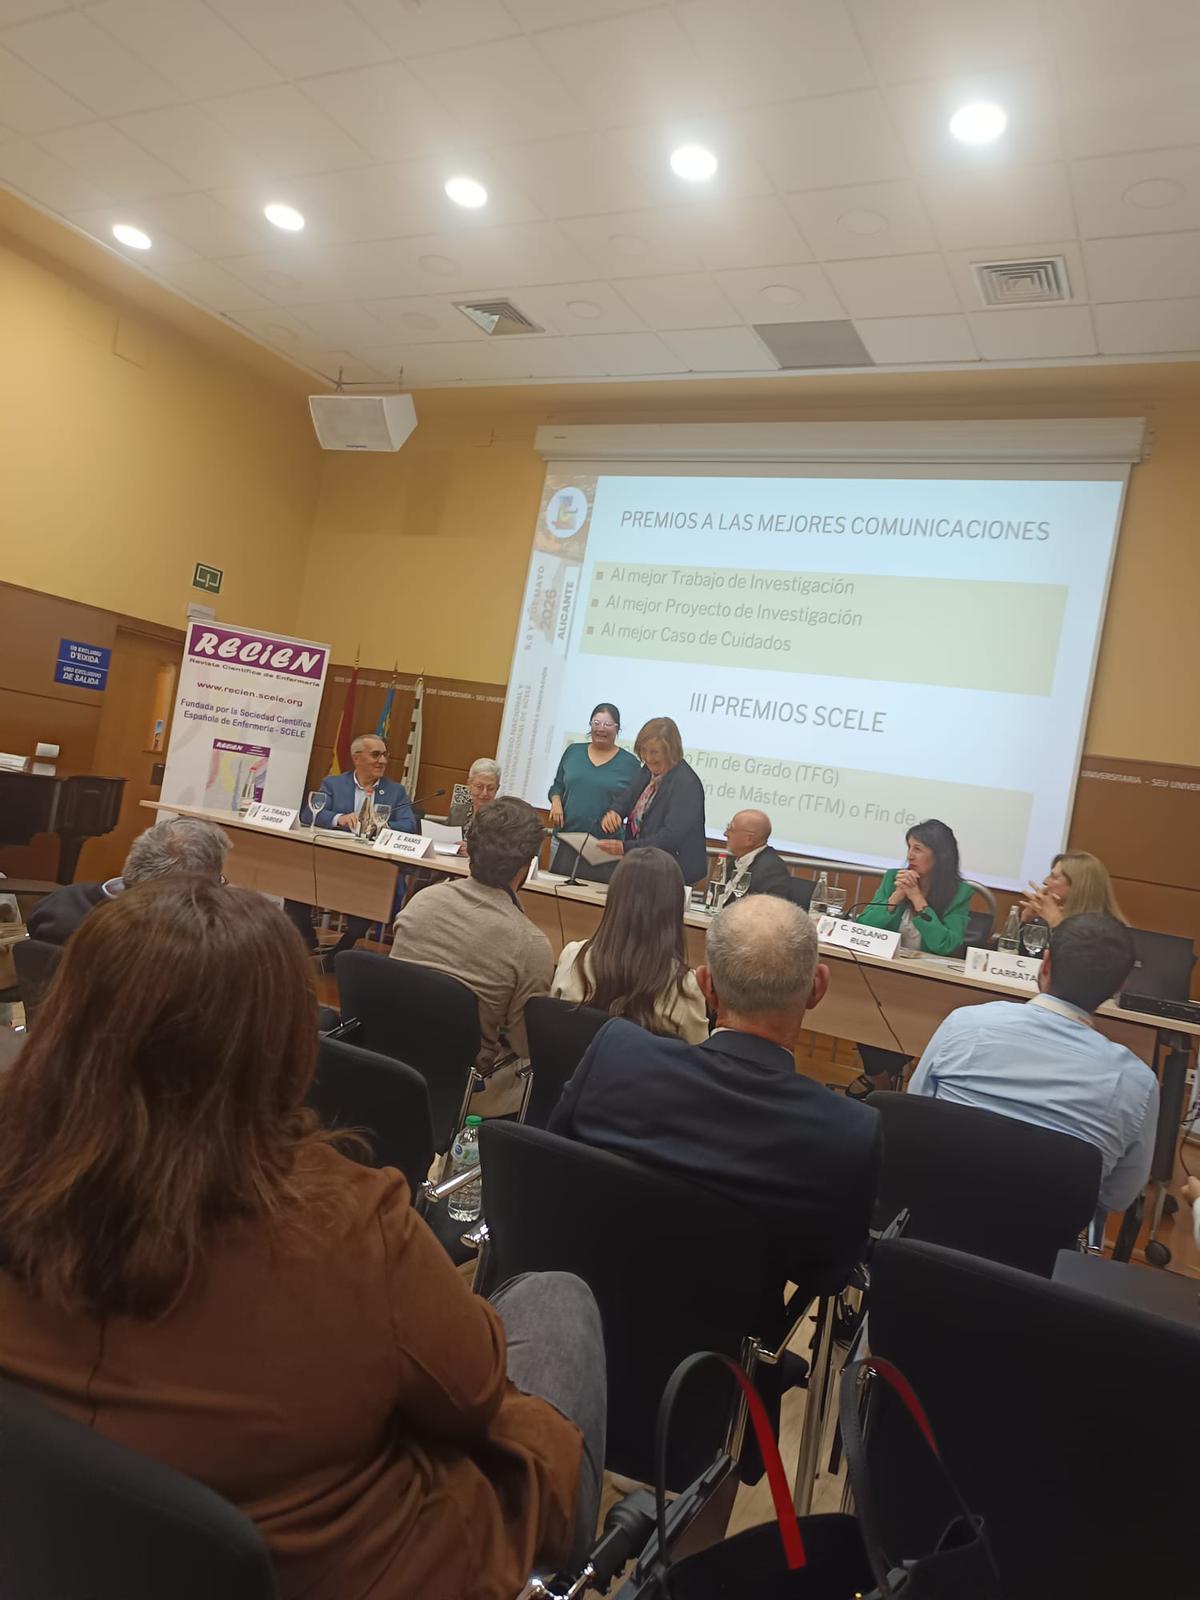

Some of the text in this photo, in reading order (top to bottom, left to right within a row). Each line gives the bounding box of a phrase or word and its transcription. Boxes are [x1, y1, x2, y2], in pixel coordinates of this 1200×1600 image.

[620, 510, 1051, 541] PREMIOS A LAS MEJORES COMUNICACIONES
[533, 564, 545, 596] MAYO
[610, 567, 855, 596] Al mejor Trabajo de Investigación
[541, 589, 557, 630] 2026
[557, 581, 574, 639] ALICANTE
[605, 594, 863, 627] Al mejor Proyecto de Investigación
[600, 622, 792, 651] Al mejor Caso de Cuidados
[70, 651, 99, 664] D'EIXIDA
[62, 672, 99, 685] DE SALIDA
[197, 681, 304, 707] www.recien.scele.org
[180, 698, 215, 711] Fundada
[215, 704, 230, 713] por
[230, 707, 238, 715] la
[240, 709, 275, 722] Sociedad
[183, 710, 220, 723] Española
[220, 717, 231, 725] de
[280, 727, 306, 738] SCELE
[689, 692, 888, 733] III PREMIOS SCELE
[697, 751, 719, 770] Fin
[722, 755, 741, 773] de
[745, 758, 792, 779] Grado
[795, 765, 840, 788] (TFG)
[717, 782, 737, 799] de
[740, 785, 795, 808] Máster
[798, 794, 846, 818] (TFM)
[850, 804, 860, 818] o
[864, 803, 890, 823] Fin
[894, 808, 916, 826] de
[393, 843, 416, 852] ORTEGA
[840, 924, 888, 941] C. SOLANO
[850, 937, 871, 948] RUIZ
[1016, 960, 1026, 968] C.
